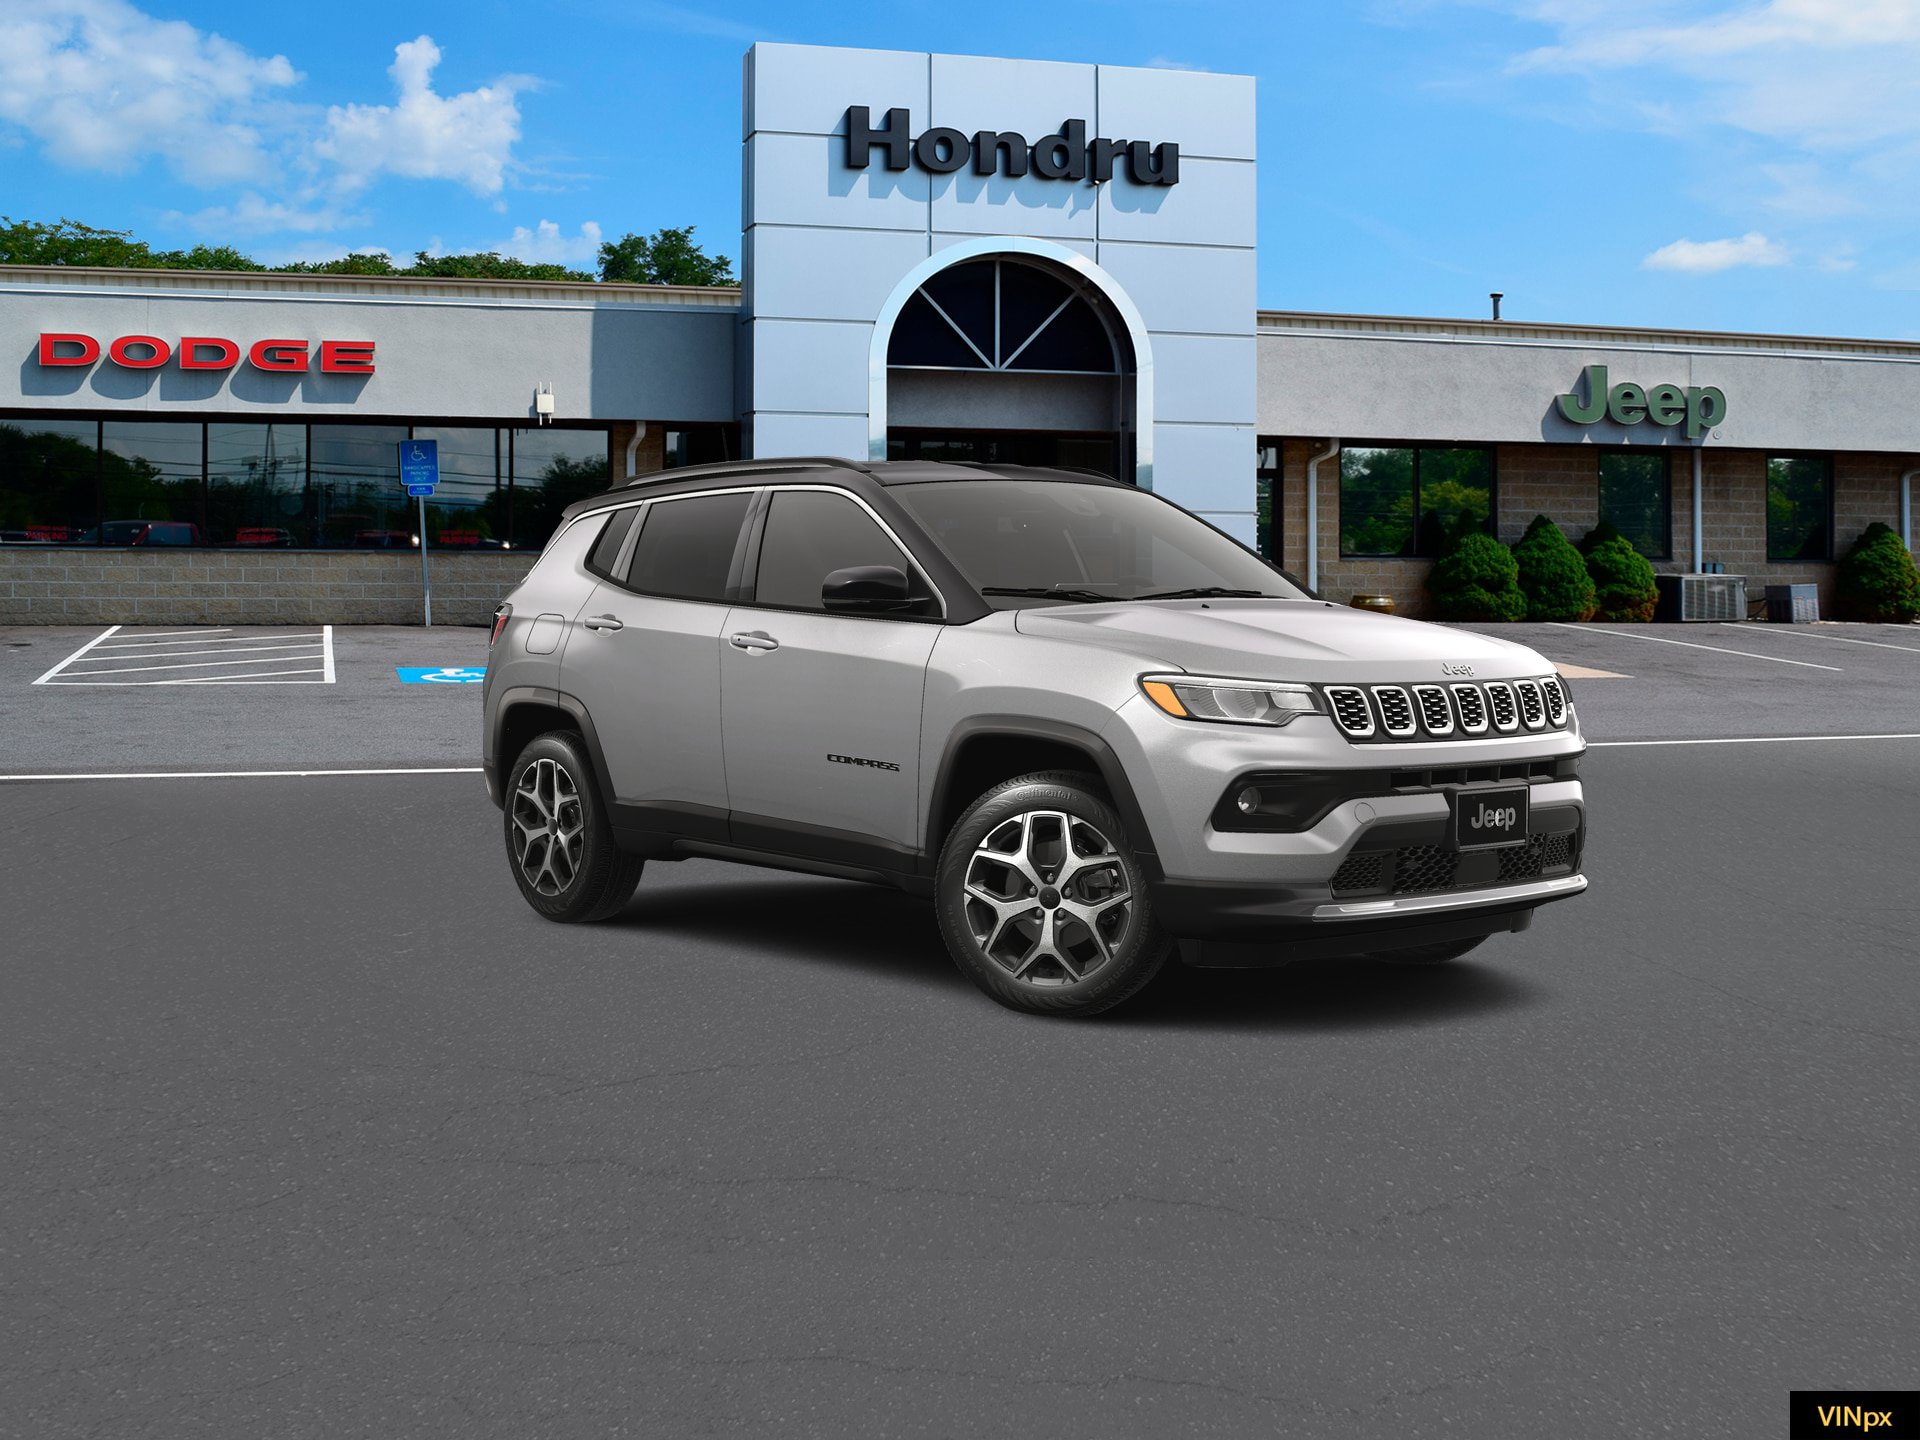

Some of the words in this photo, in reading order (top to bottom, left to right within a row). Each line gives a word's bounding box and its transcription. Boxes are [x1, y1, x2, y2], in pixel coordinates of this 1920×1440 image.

[846, 104, 1180, 186] Hondru
[39, 332, 376, 373] DODGE
[1555, 365, 1727, 439] Jeep
[1442, 662, 1474, 676] Jeep
[827, 754, 900, 772] COMPASS
[1471, 803, 1516, 831] Jeep
